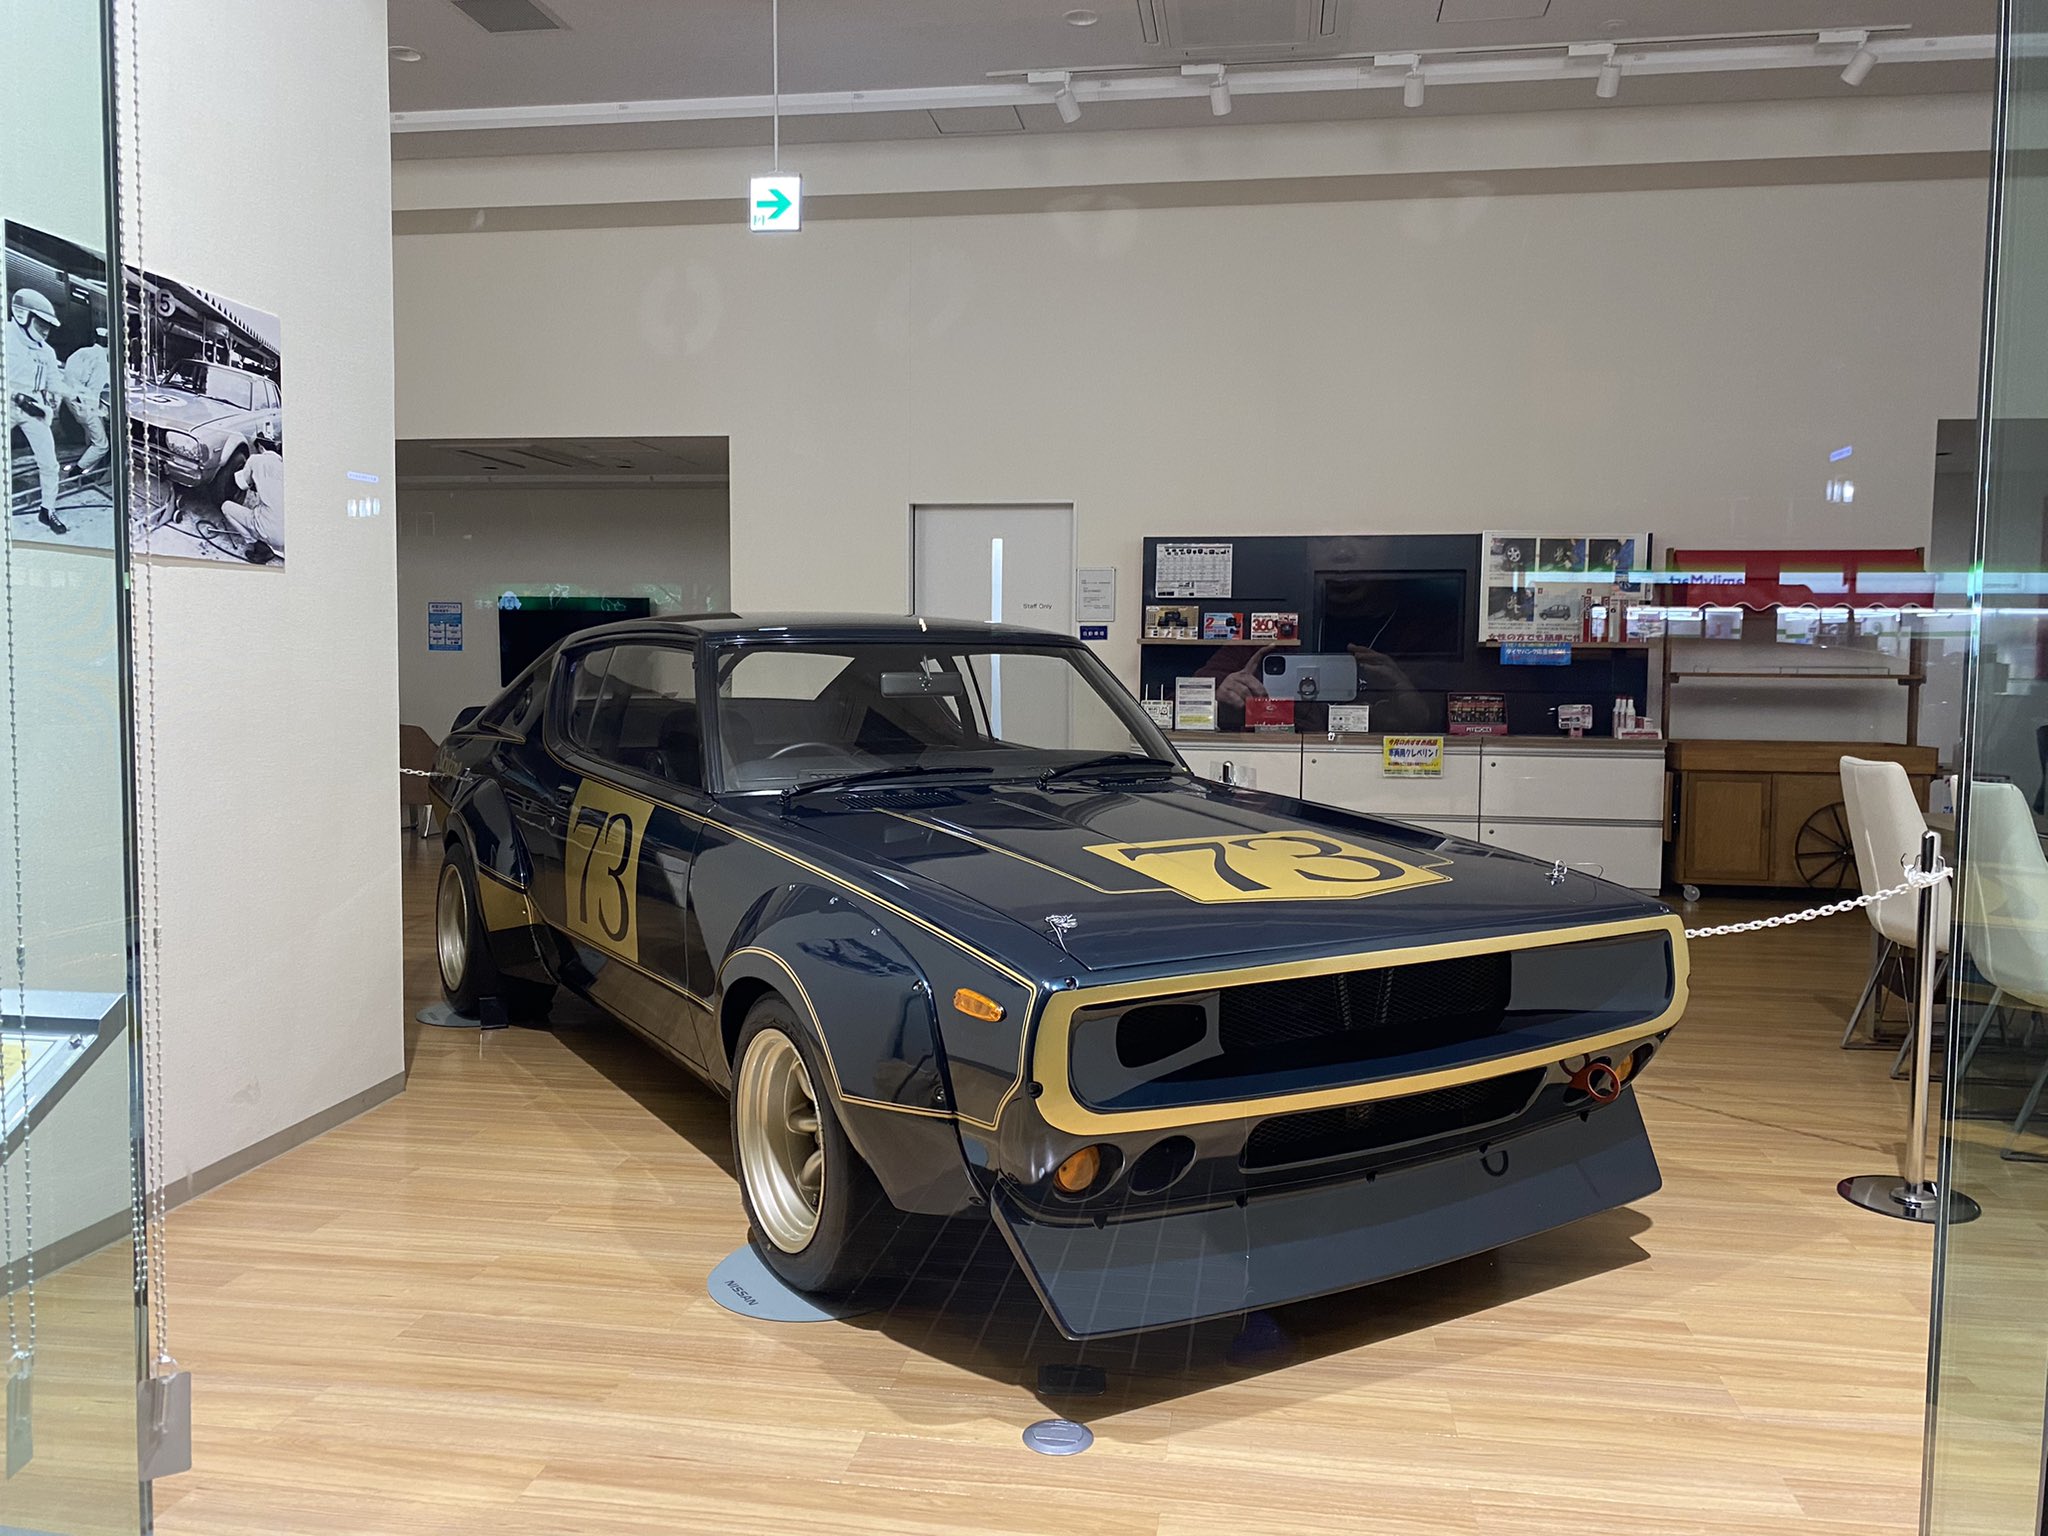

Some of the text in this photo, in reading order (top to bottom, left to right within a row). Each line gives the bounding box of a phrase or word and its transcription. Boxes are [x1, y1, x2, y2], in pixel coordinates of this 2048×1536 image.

[160, 293, 170, 312] 5
[1205, 617, 1215, 629] 2
[573, 806, 633, 942] 73
[1117, 836, 1406, 892] 73
[724, 1280, 759, 1307] NISSAN
